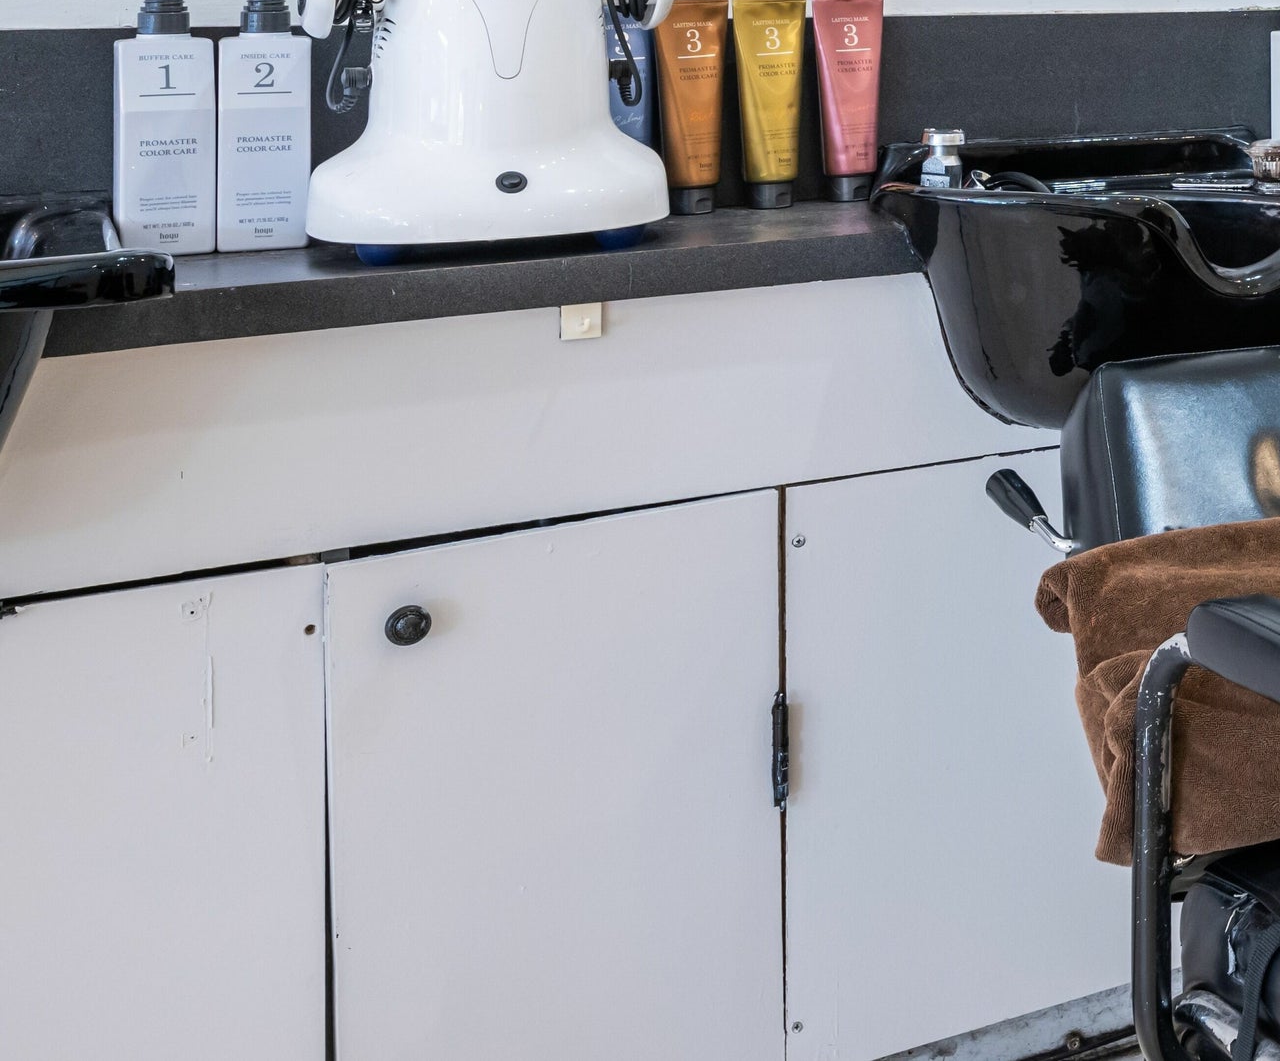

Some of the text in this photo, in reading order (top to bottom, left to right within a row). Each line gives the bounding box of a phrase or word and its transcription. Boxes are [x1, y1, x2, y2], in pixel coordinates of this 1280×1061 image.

[686, 28, 702, 53] 3
[765, 26, 781, 50] 3
[844, 23, 859, 46] 3
[158, 64, 177, 90] 1
[254, 62, 274, 88] 2
[140, 138, 198, 147] PROMASTER
[237, 135, 293, 144] PROMASTER
[139, 149, 172, 157] COLOR
